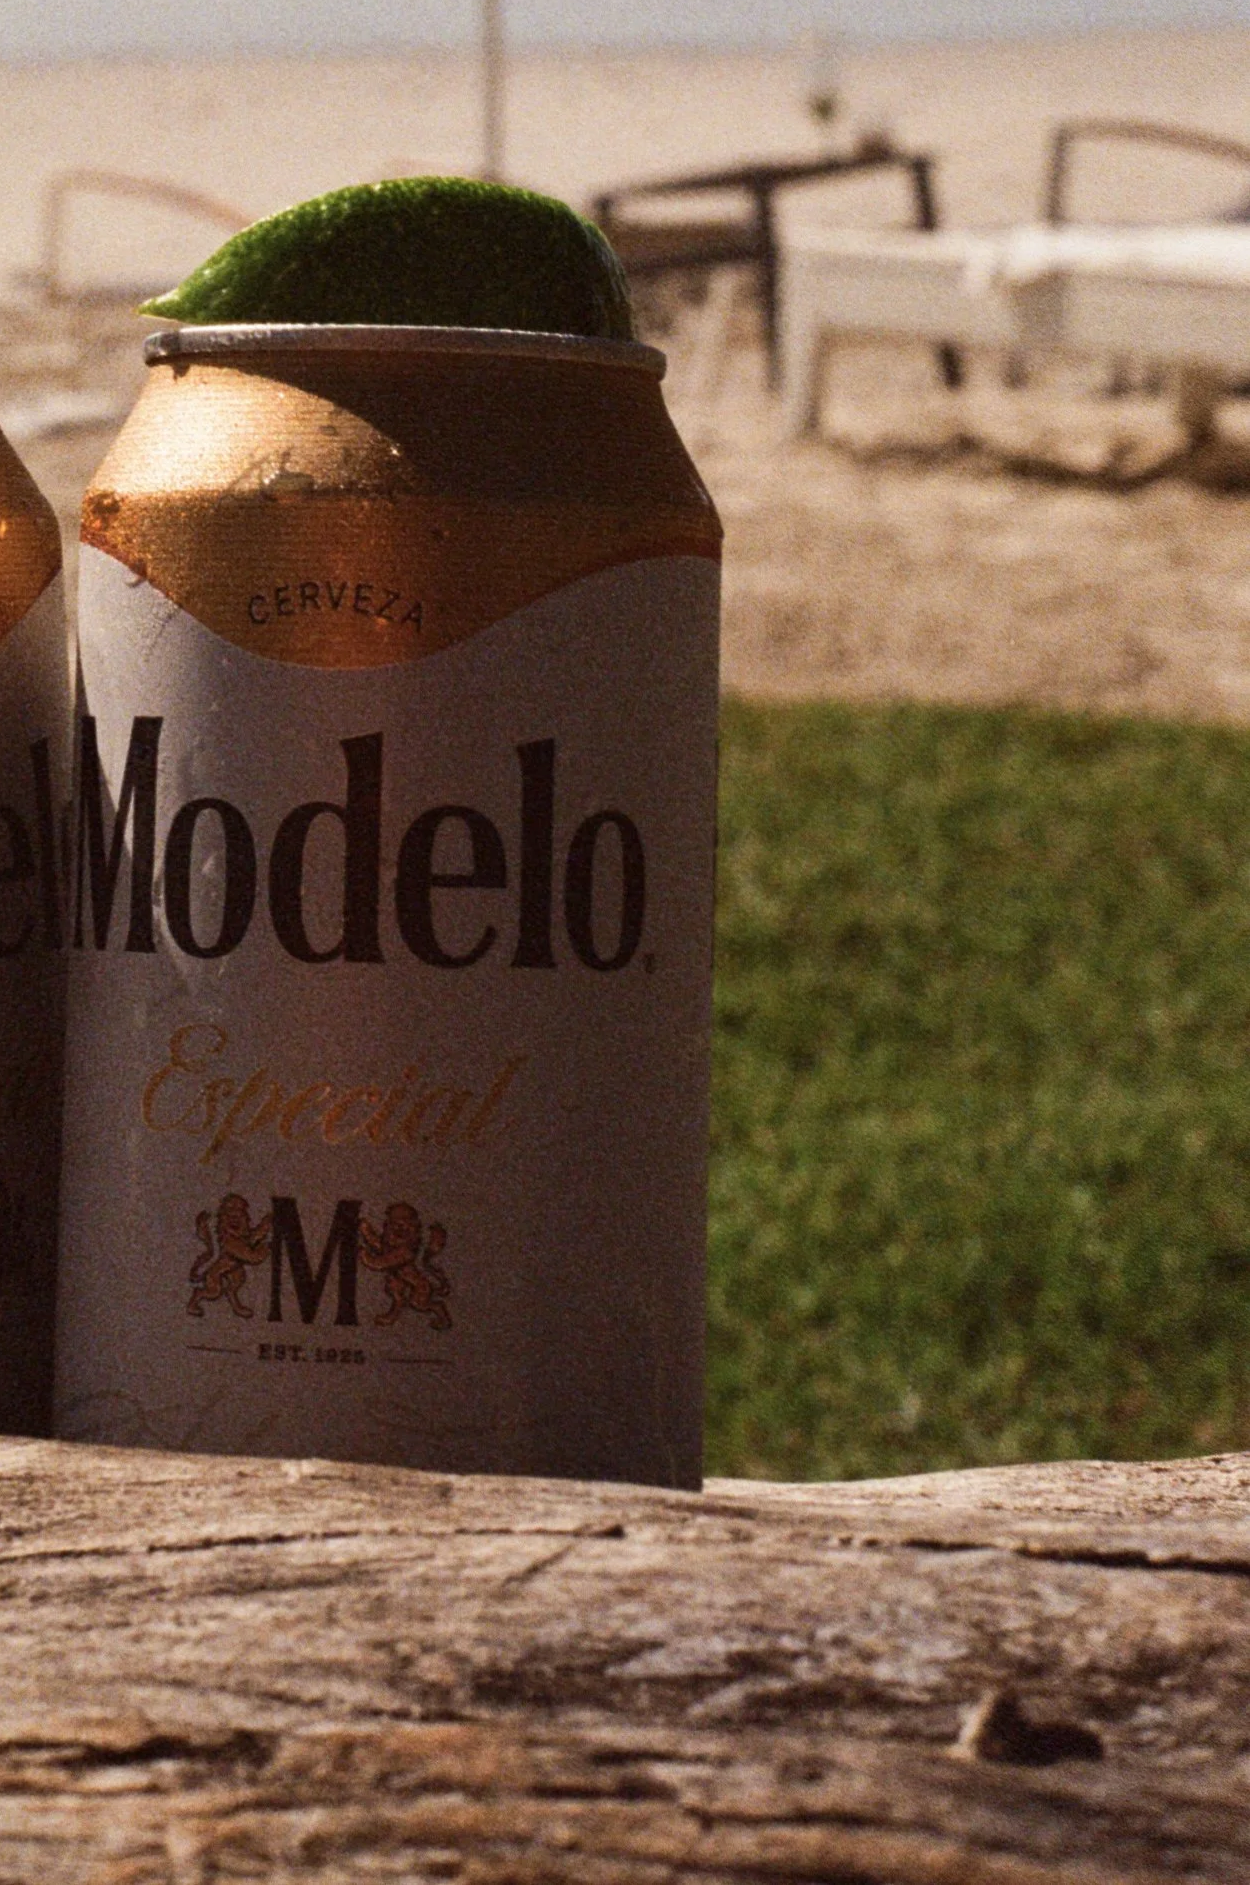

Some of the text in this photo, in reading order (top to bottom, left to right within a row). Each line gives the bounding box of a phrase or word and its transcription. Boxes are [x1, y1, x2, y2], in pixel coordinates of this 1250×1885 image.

[249, 581, 423, 634] CERVEZA
[74, 715, 648, 972] Modelo
[143, 1022, 529, 1165] Especial
[267, 1196, 363, 1326] M
